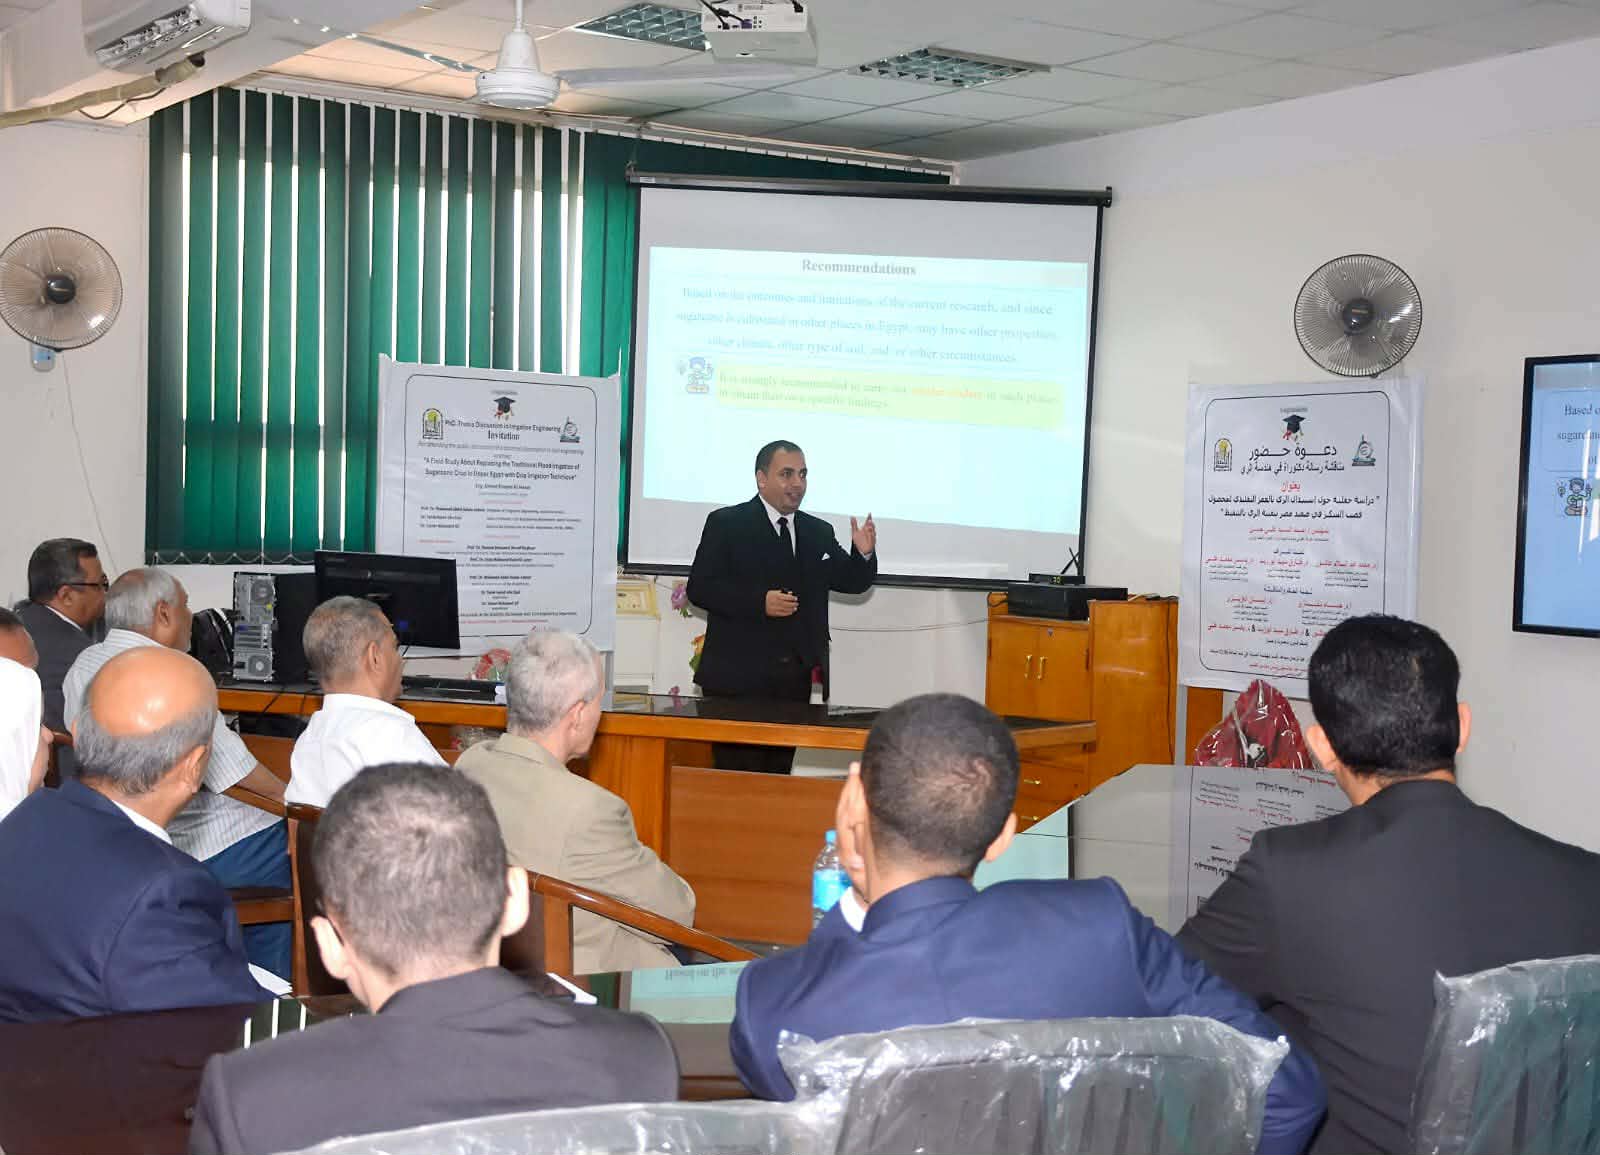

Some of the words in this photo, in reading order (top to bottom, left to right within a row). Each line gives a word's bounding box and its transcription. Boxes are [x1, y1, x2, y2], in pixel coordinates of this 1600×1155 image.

[802, 259, 917, 276] Recommendations
[1001, 302, 1021, 313] and
[1564, 403, 1593, 416] Based
[1595, 406, 1600, 415] o
[487, 430, 520, 441] Invitation
[1249, 444, 1291, 461] حضور
[1295, 443, 1337, 460] دعوة
